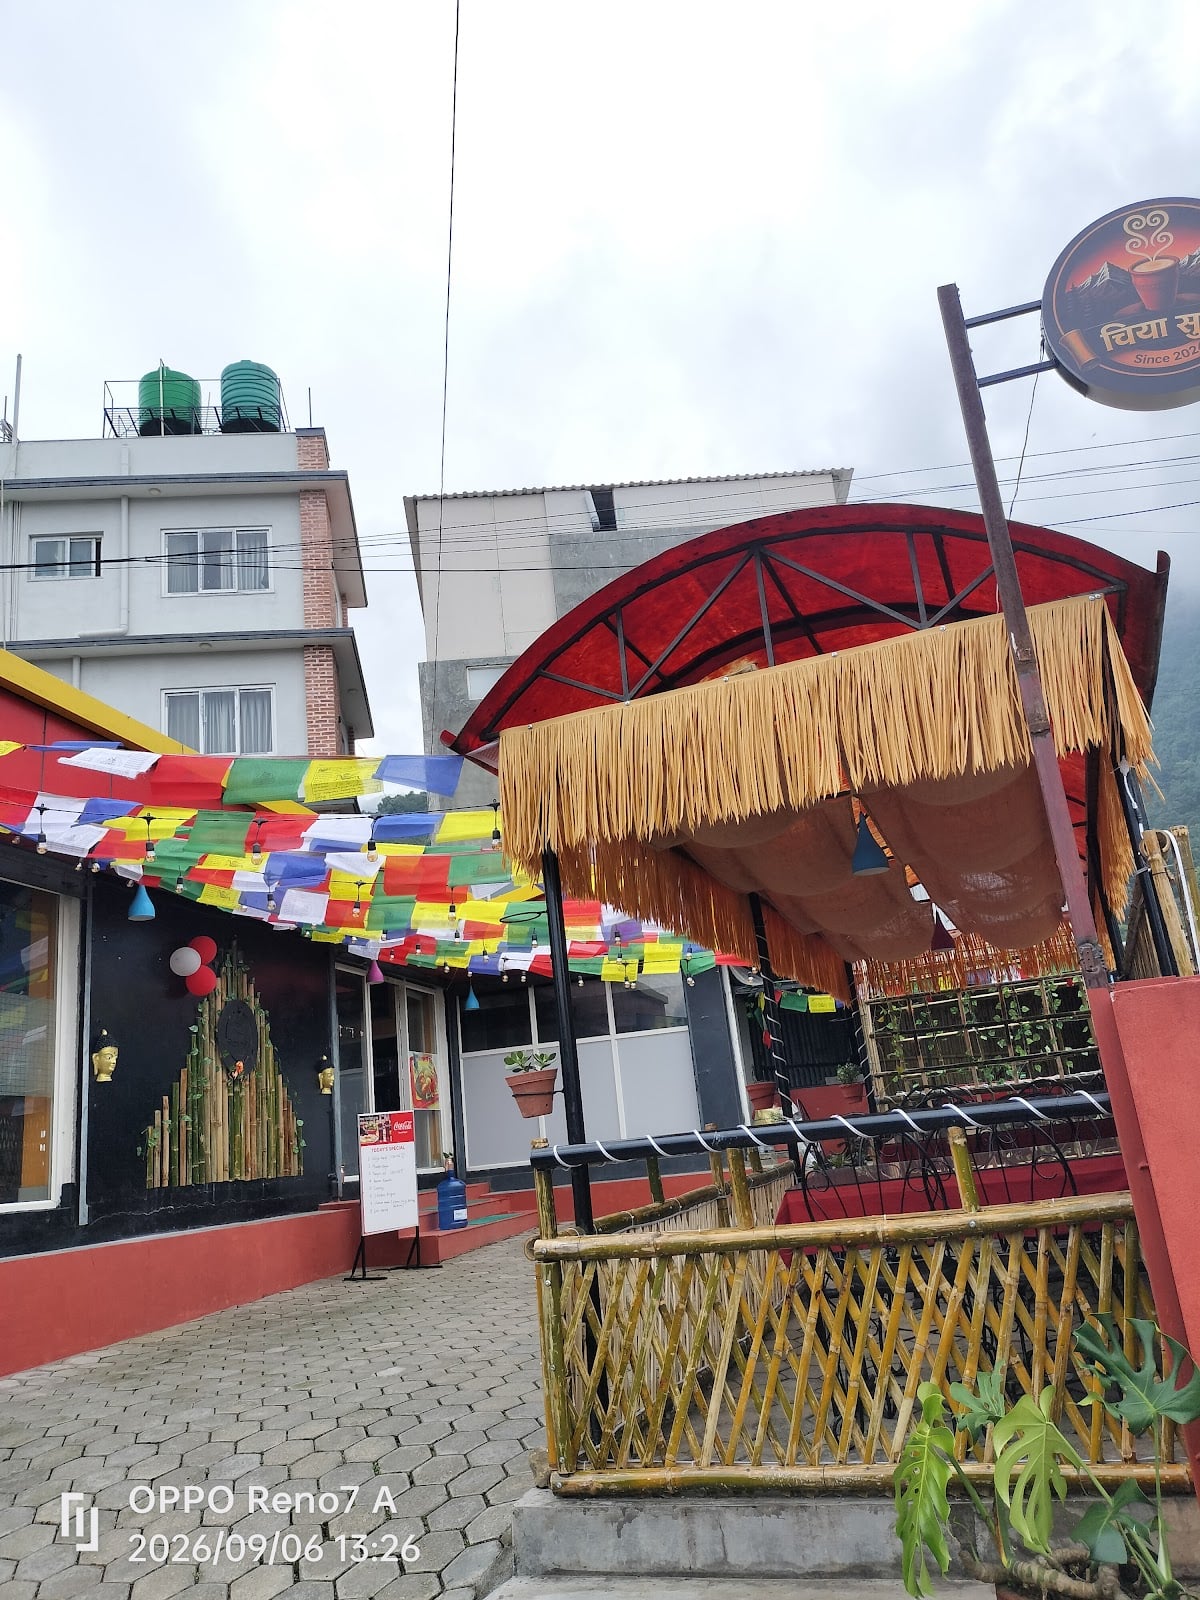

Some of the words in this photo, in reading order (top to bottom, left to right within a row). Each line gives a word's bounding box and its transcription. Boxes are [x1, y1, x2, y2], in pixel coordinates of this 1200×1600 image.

[1100, 318, 1168, 351] चिया
[1134, 354, 1170, 364] Since
[1173, 343, 1200, 361] 202
